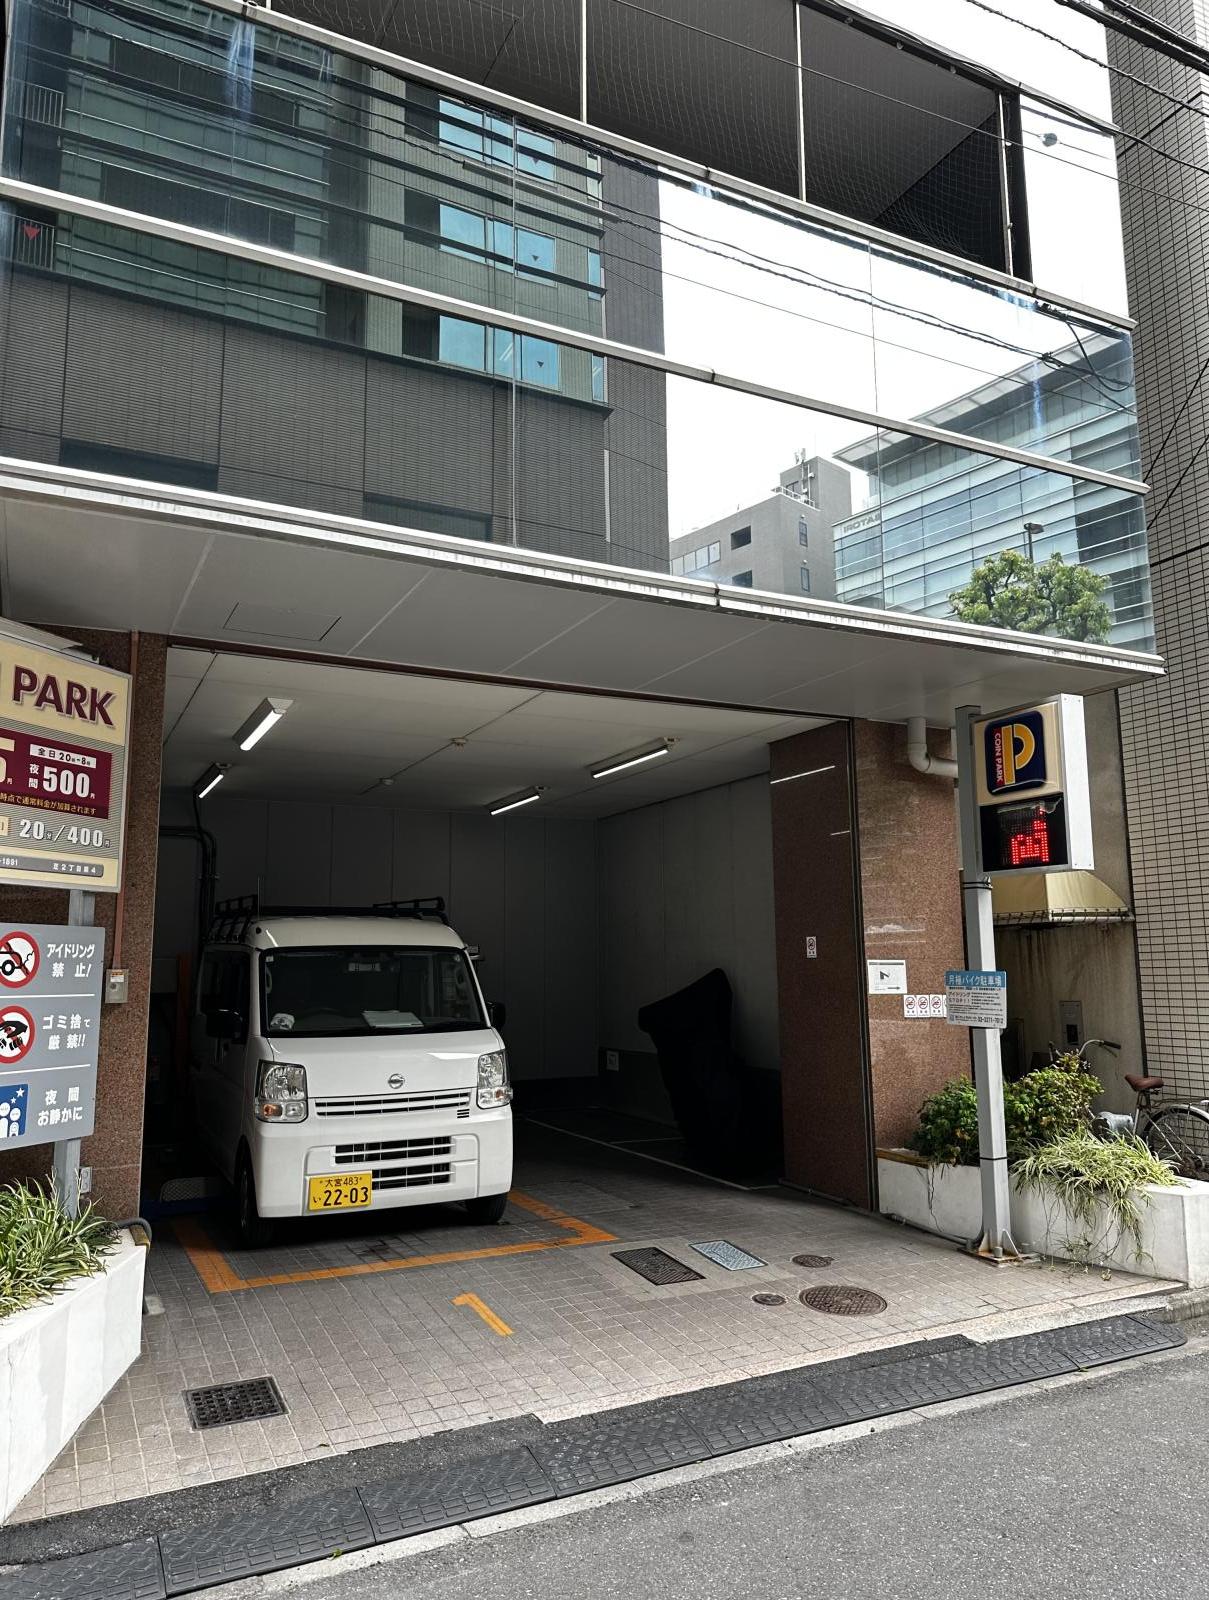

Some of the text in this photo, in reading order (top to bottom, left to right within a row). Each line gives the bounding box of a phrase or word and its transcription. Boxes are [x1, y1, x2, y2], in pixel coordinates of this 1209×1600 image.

[12, 664, 116, 727] PARK
[994, 732, 1004, 782] COIN PARK
[46, 943, 96, 959] アイドリング
[42, 1013, 91, 1030] ゴミ捨て
[37, 1105, 83, 1126] お静かに
[323, 1186, 369, 1206] 22-03
